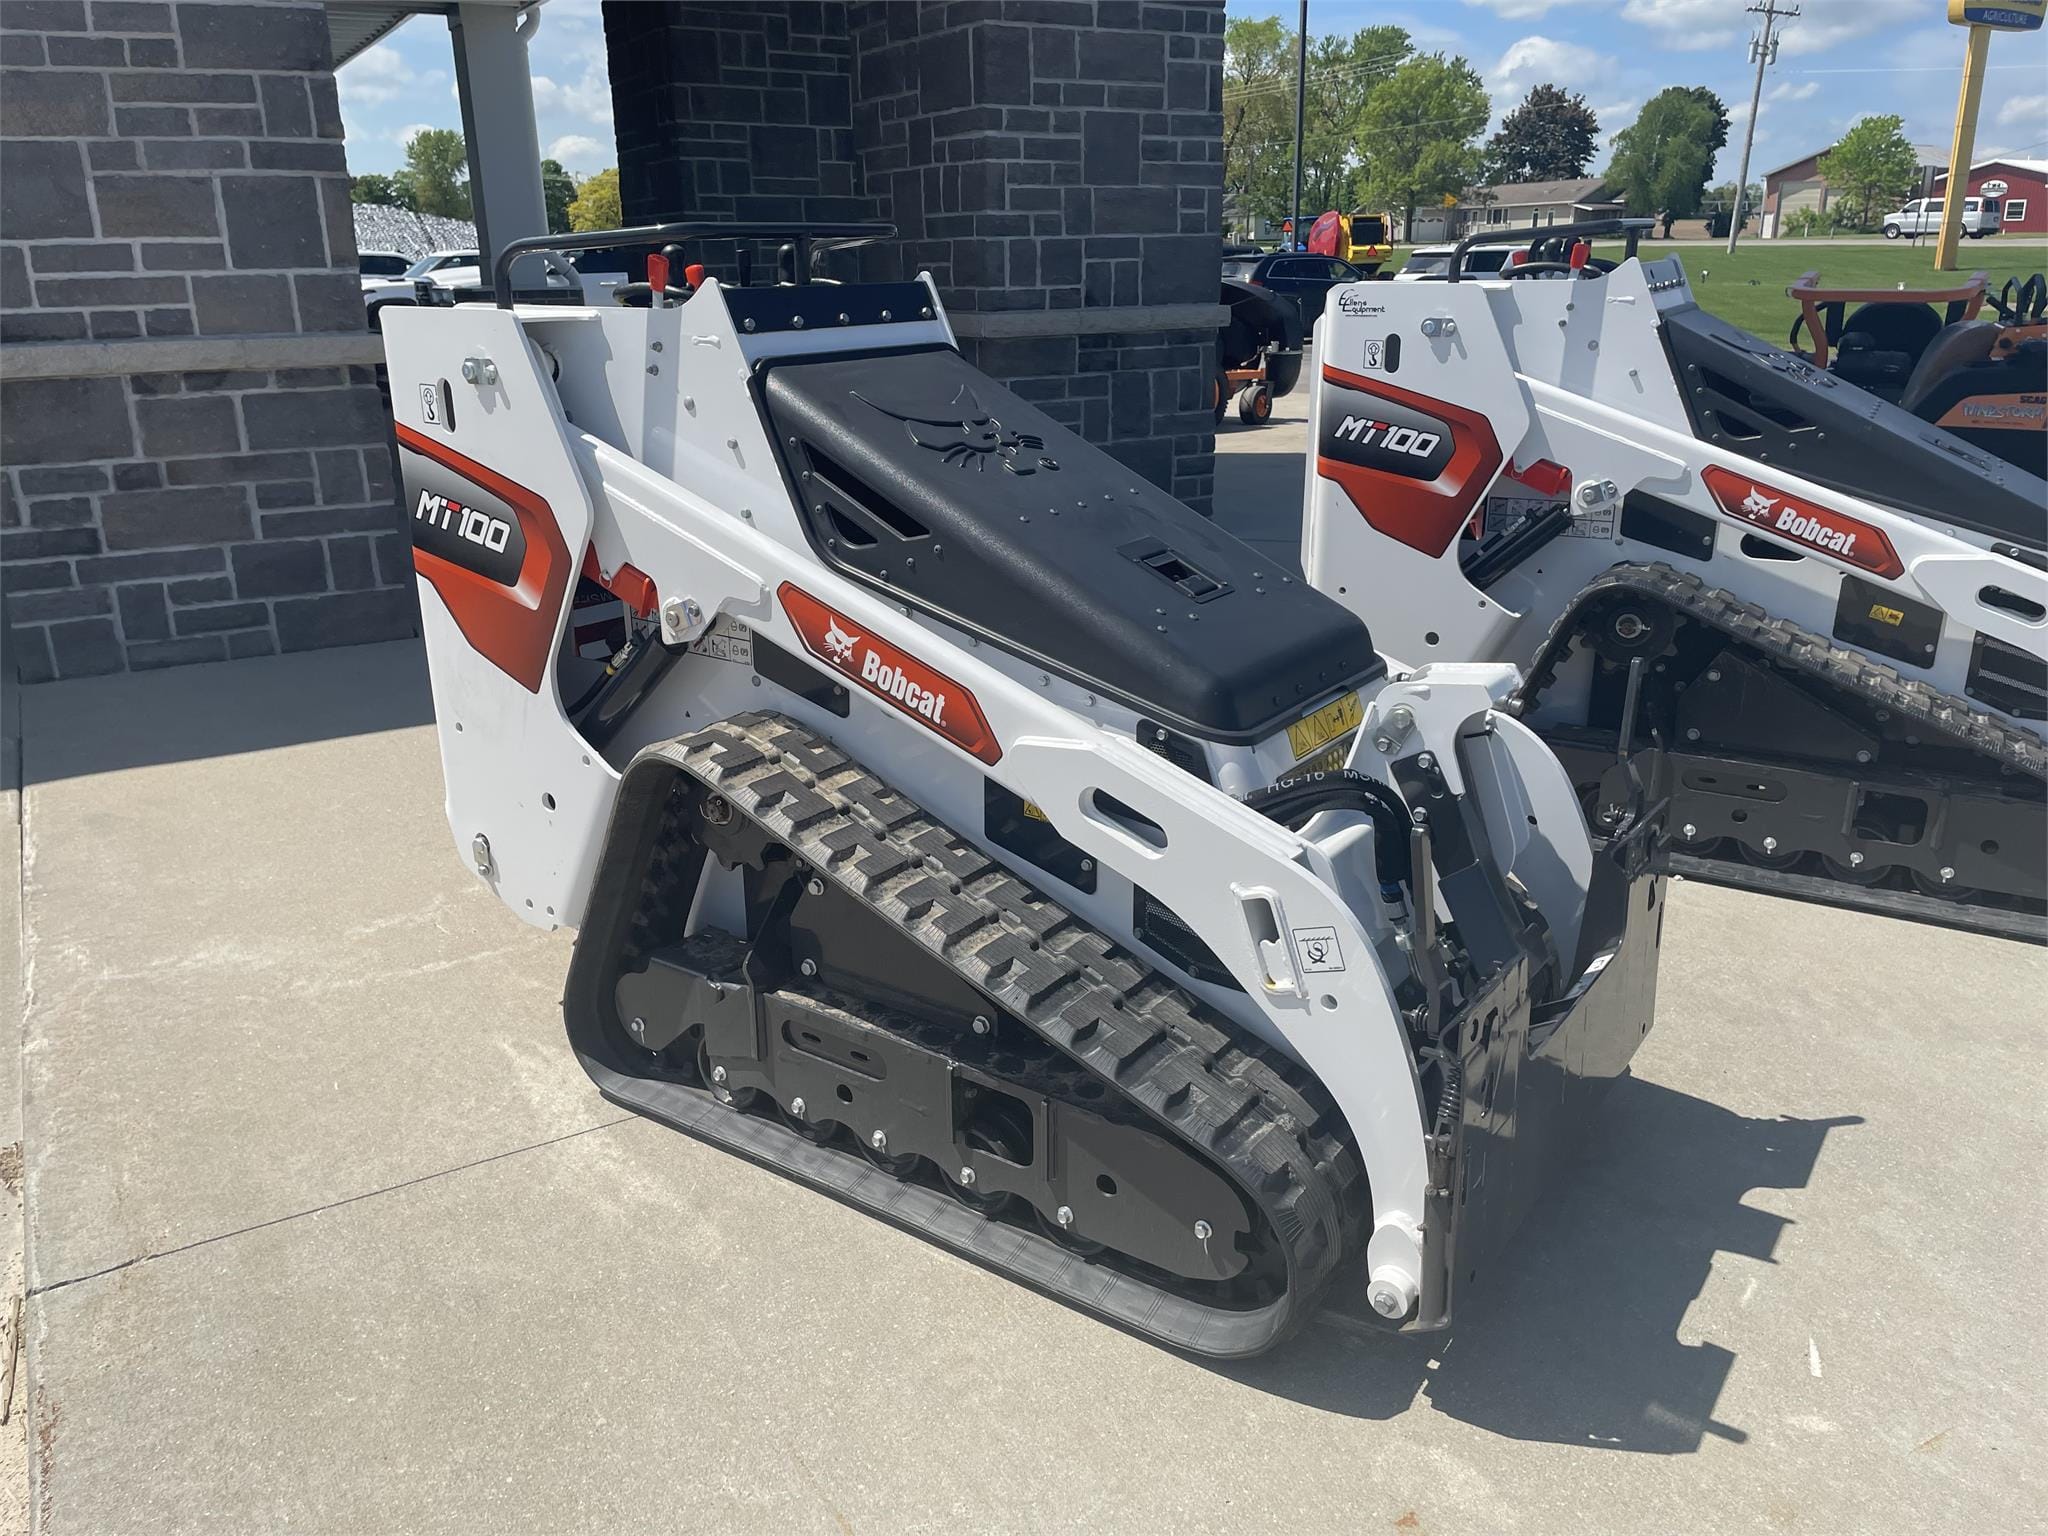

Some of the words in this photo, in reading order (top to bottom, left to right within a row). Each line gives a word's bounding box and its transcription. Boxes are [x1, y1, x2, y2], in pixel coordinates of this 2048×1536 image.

[1342, 297, 1386, 314] Equipment
[1334, 415, 1441, 458] MT100
[415, 489, 511, 554] MT100
[1775, 506, 1856, 556] Bobcat
[861, 648, 946, 727] Bobcat
